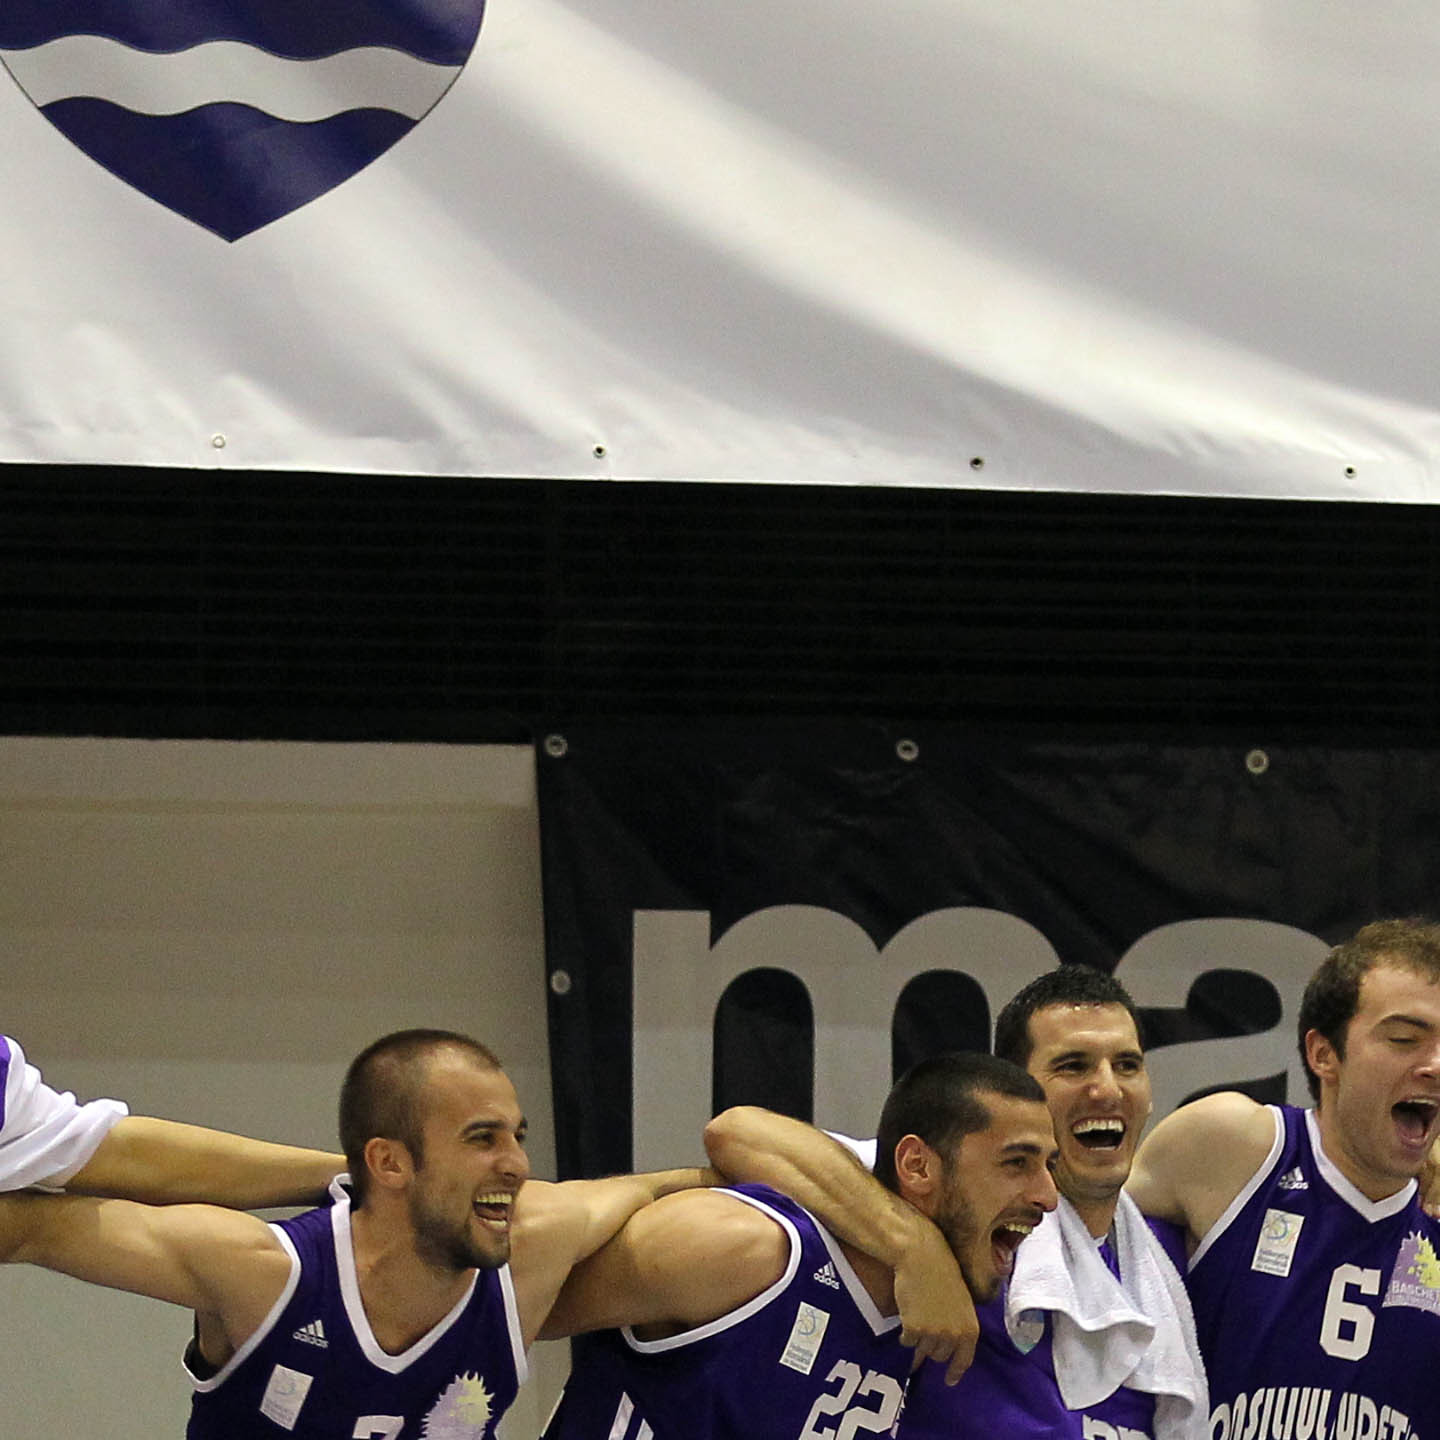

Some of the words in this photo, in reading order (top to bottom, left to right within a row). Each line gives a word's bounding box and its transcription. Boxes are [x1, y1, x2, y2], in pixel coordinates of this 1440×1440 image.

[813, 1272, 840, 1290] adidas
[1319, 1263, 1382, 1362] 6
[292, 1331, 329, 1348] adidas
